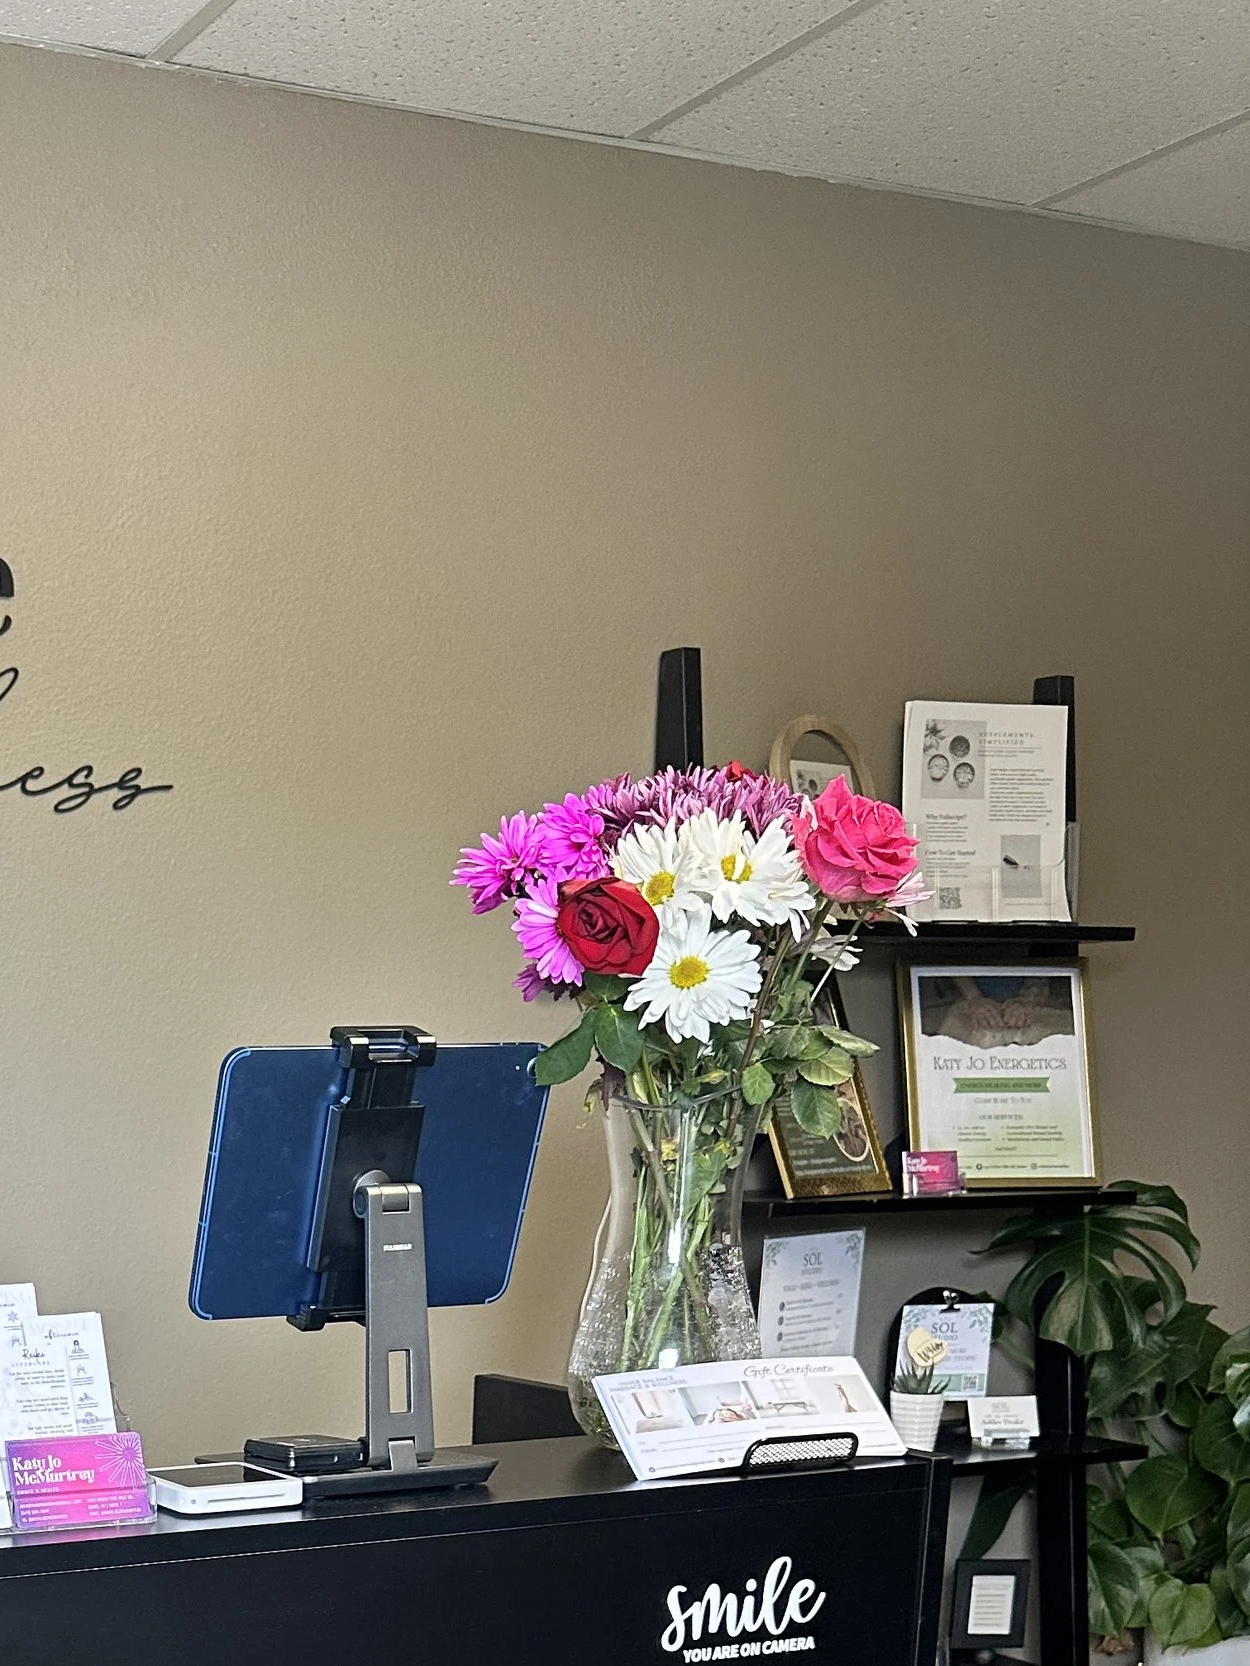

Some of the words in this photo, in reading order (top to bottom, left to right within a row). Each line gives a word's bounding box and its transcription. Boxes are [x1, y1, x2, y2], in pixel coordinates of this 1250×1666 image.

[802, 1252, 823, 1267] SOL
[931, 1322, 958, 1334] SOL
[743, 1365, 771, 1379] Gift
[774, 1363, 835, 1377] Certificate
[12, 1456, 46, 1473] Katy
[47, 1455, 62, 1468] Jo
[14, 1468, 95, 1486] McMurtrey
[661, 1556, 827, 1652] smile
[682, 1647, 712, 1664] YOU
[711, 1643, 740, 1660] ARE
[740, 1642, 761, 1658] ON
[761, 1636, 816, 1655] CAMERA
